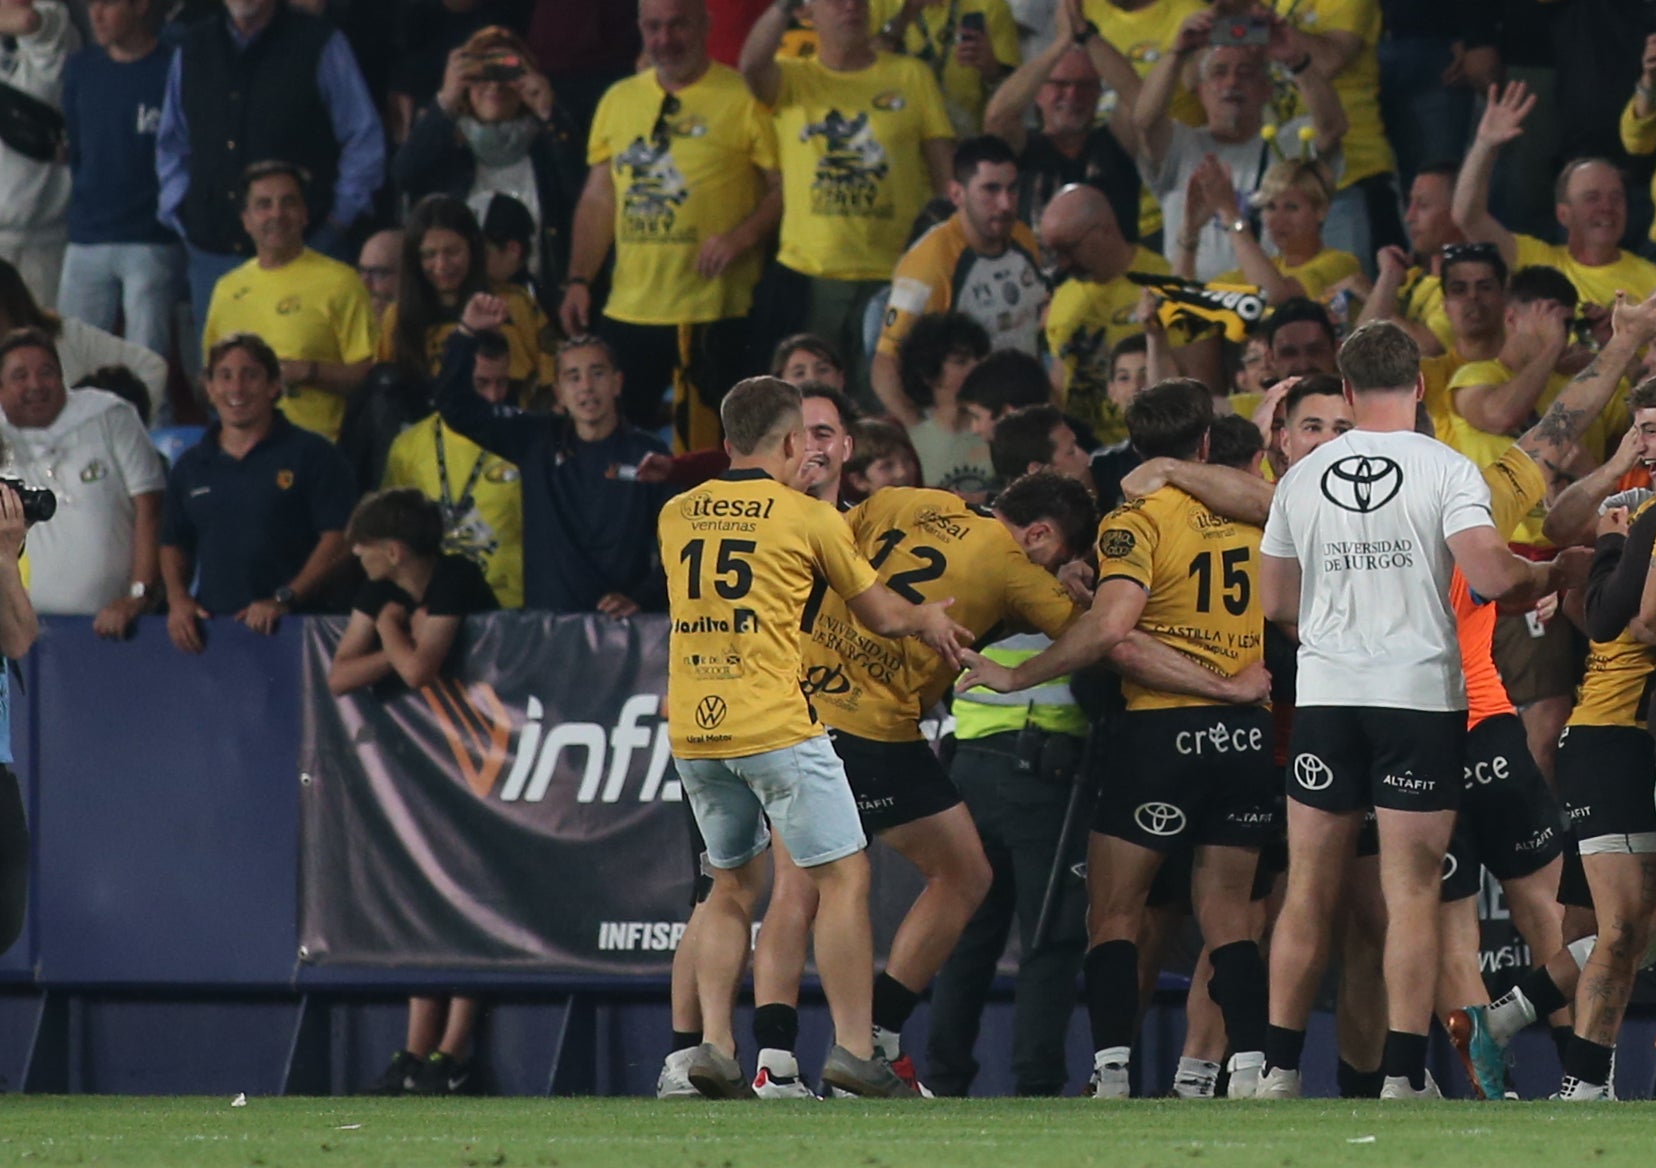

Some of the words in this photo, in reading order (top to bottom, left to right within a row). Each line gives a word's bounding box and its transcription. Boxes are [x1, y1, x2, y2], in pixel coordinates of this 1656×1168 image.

[693, 497, 775, 519] itesal
[691, 519, 757, 532] ventanas
[1323, 539, 1412, 556] UNIVERSIDAD
[680, 538, 757, 600] 15
[869, 528, 947, 605] 12
[1324, 559, 1342, 572] DE
[1188, 545, 1252, 616] 15
[1228, 633, 1236, 648] Y
[500, 694, 683, 804] infi
[1175, 722, 1262, 755] crece
[1383, 774, 1436, 791] ALTAFIT
[1567, 805, 1592, 819] AFIT
[1514, 826, 1554, 852] ALTAFIT
